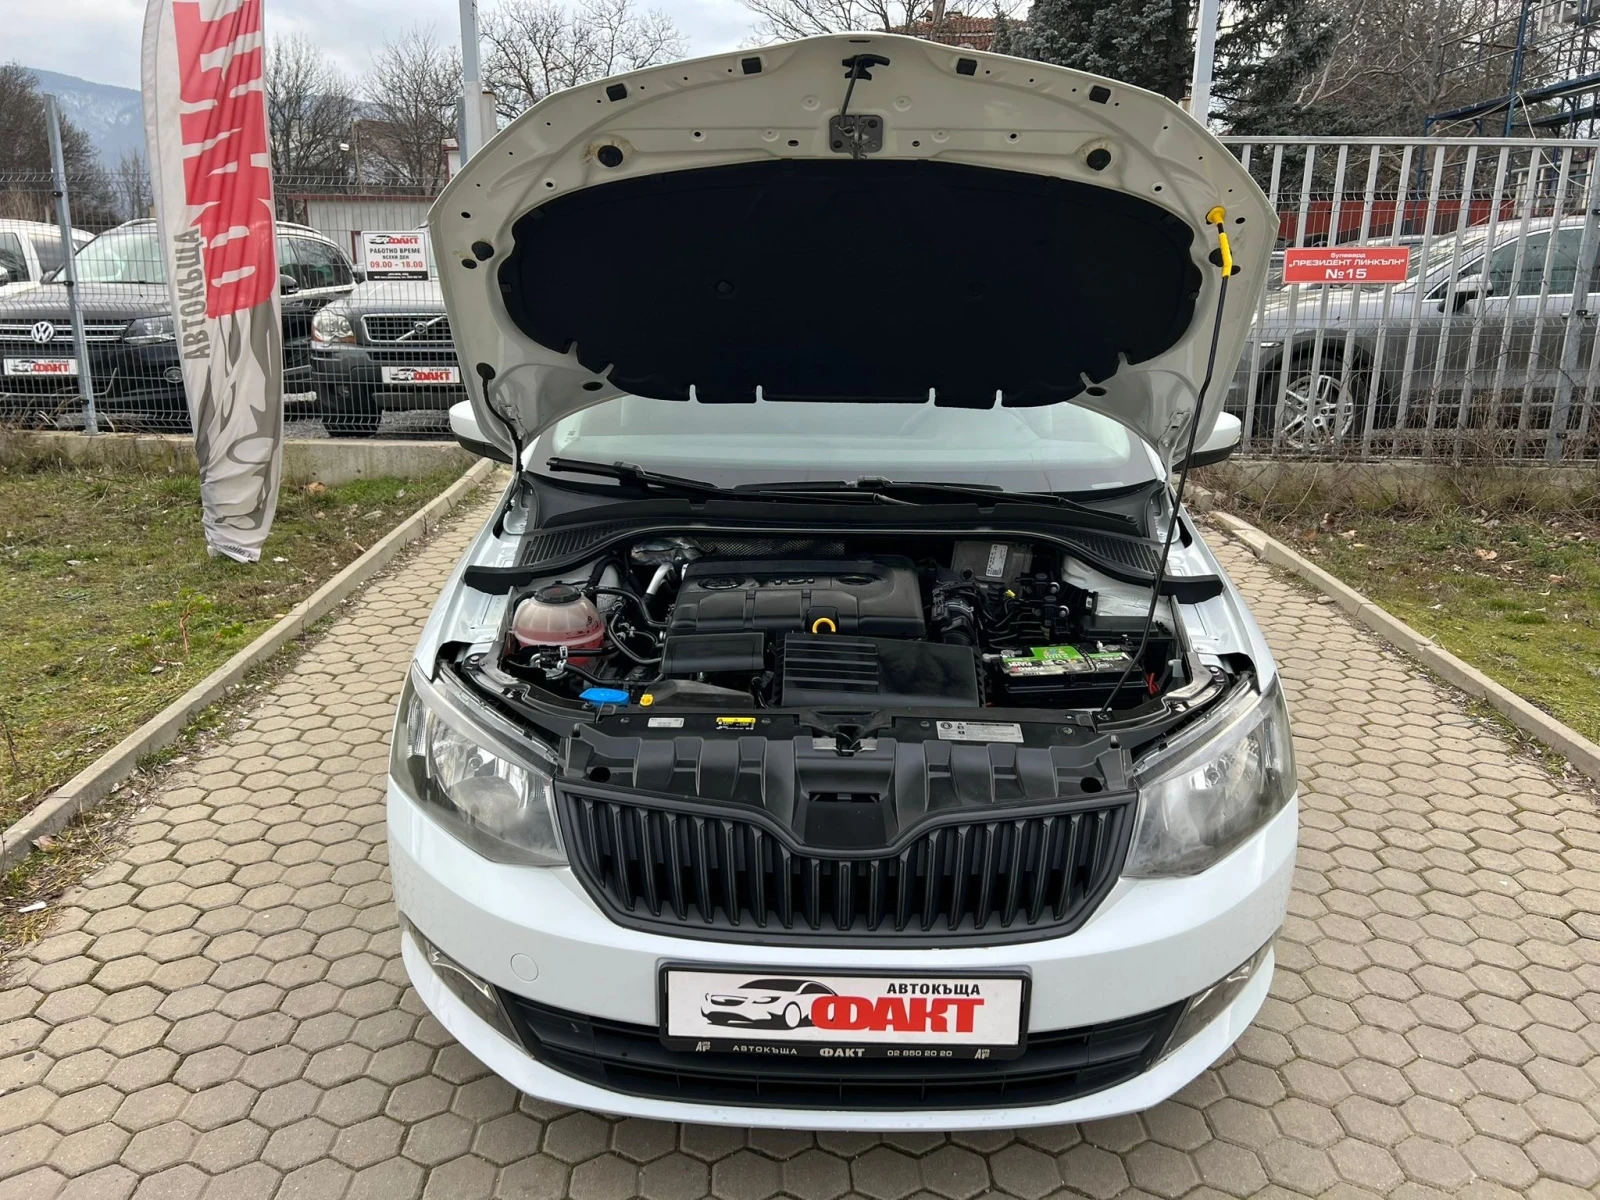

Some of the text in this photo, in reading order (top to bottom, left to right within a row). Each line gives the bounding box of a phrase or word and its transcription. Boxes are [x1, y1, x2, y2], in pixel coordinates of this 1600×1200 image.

[1288, 259, 1351, 267] „ПРЕЗИДЕНТ
[1325, 268, 1368, 279] №15
[174, 228, 211, 360] АВТОКЪЩА
[887, 983, 981, 997] АВТОКЪЩА
[811, 996, 985, 1032] ФАКТ
[732, 1044, 798, 1055] АВТОКЪЩА
[820, 1047, 866, 1057] ФАКТ
[887, 1049, 900, 1057] 02
[924, 1049, 937, 1057] 20
[940, 1049, 953, 1057] 20
